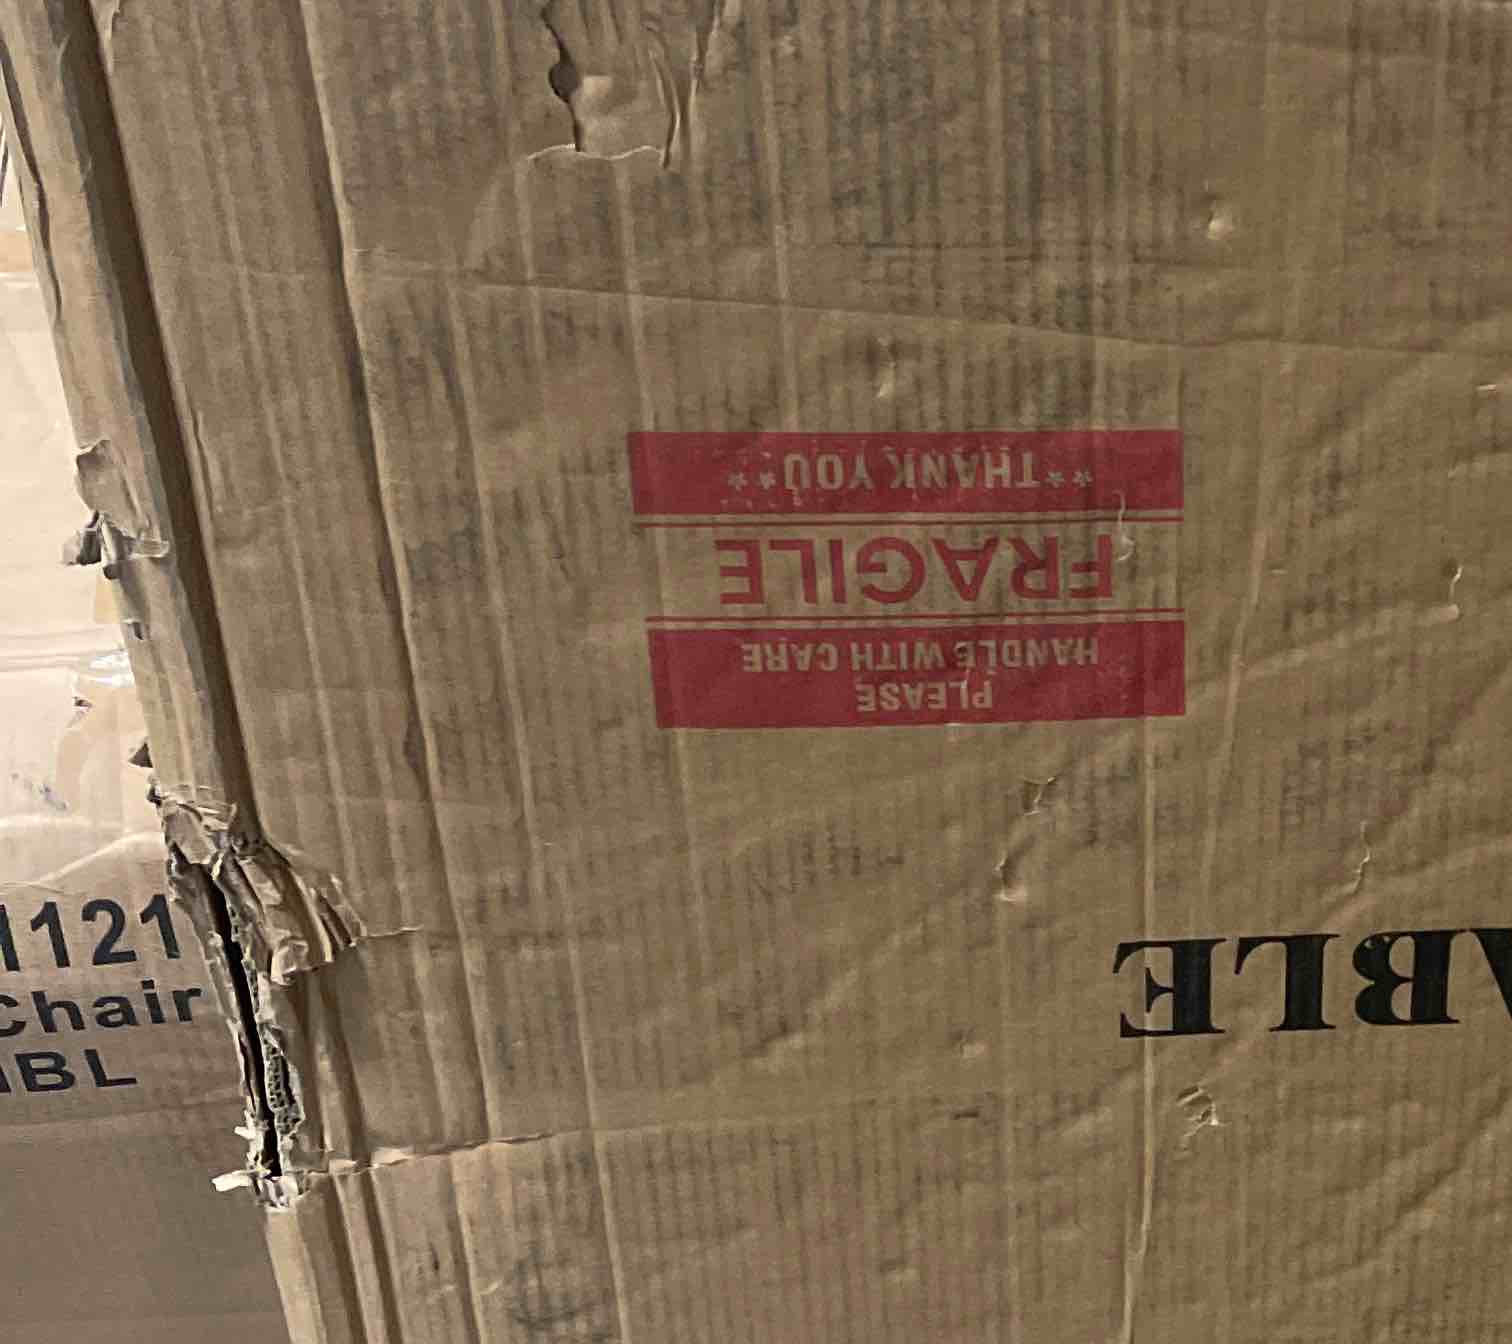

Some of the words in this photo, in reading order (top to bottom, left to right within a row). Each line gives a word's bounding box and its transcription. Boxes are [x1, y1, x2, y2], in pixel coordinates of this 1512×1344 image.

[712, 534, 1115, 605] FRAGILE
[740, 642, 839, 674] CARE
[850, 639, 943, 671] WITH
[955, 637, 1099, 672] HANDLE
[855, 679, 993, 713] PLEASE
[0, 1049, 138, 1094] BL
